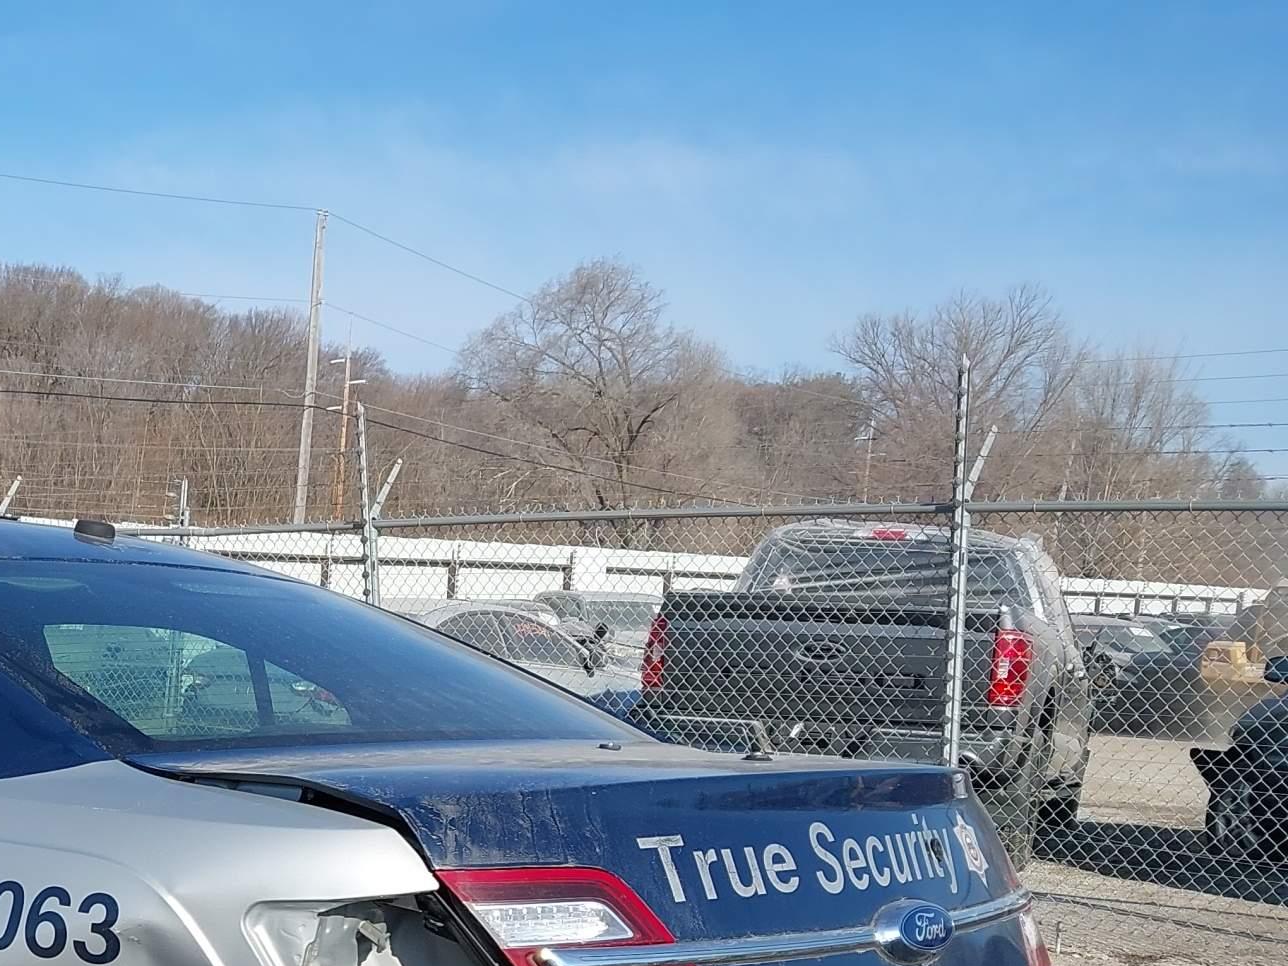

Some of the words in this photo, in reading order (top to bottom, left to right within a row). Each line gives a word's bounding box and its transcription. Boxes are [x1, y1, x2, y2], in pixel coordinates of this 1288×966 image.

[635, 834, 800, 903] True
[808, 812, 958, 895] Security
[915, 912, 947, 942] Ford
